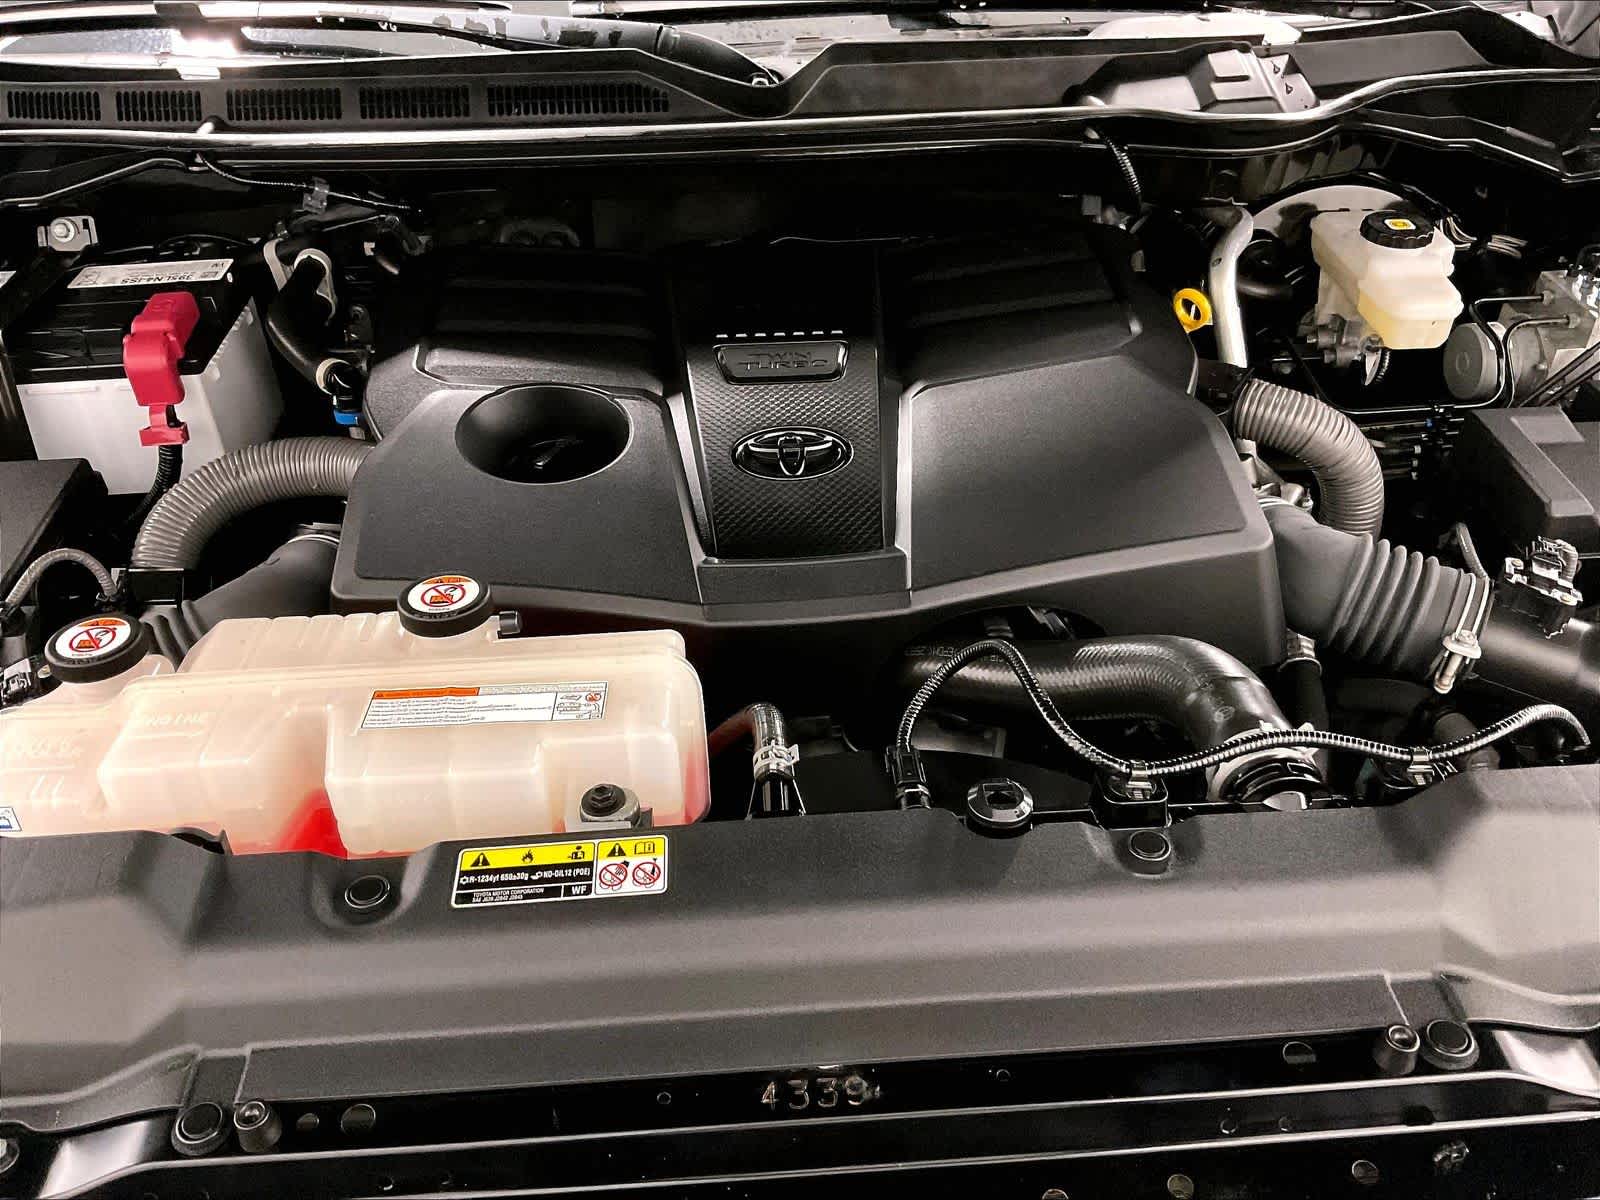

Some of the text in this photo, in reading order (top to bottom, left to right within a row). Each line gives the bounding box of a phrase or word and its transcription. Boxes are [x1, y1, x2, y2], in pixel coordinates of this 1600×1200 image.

[747, 351, 811, 360] TWIN
[737, 359, 829, 370] TURBO
[473, 887, 545, 898] TOYOTA MOTOR CORPORATION
[571, 885, 587, 895] WF
